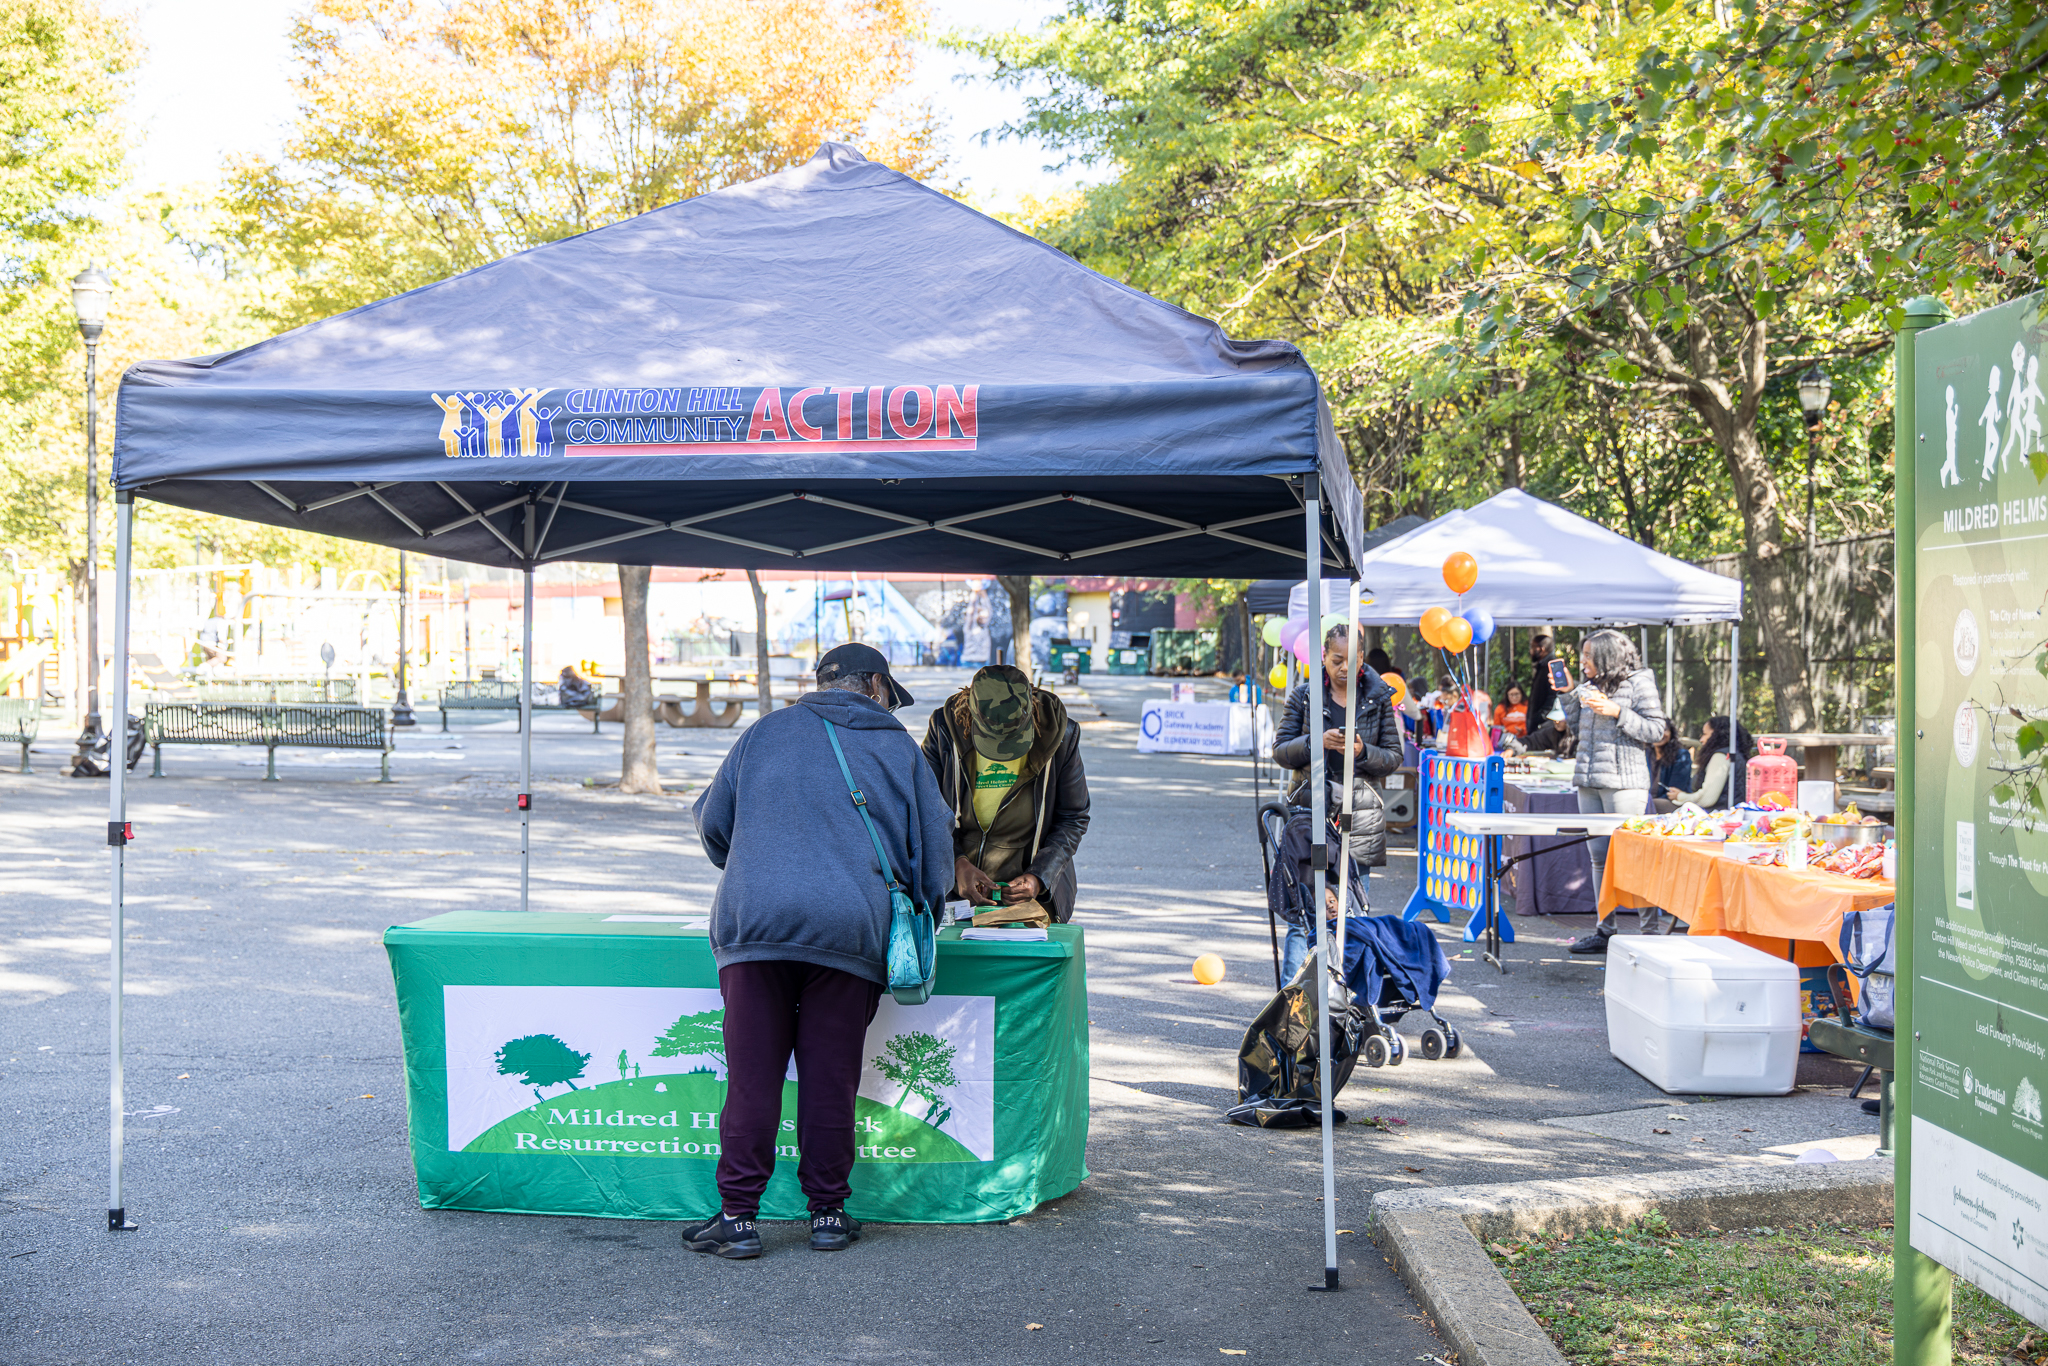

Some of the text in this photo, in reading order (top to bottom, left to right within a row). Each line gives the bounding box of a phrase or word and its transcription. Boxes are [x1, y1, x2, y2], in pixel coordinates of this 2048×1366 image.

[566, 387, 743, 413] CLINTON HILL
[566, 384, 981, 444] COMMUNITY ACTION
[1943, 496, 2047, 533] MILDRED HELMS
[1953, 568, 2029, 588] Restored in partnership with:
[1990, 609, 1999, 621] The
[2000, 609, 2011, 624] City
[2012, 608, 2018, 620] of
[1164, 710, 1185, 719] BRICK
[1164, 721, 1224, 731] Gateway Academy
[1164, 736, 1223, 747] ELEMENTARY SCHOOL
[1989, 852, 2007, 868] Through
[2008, 854, 2018, 868] The
[2019, 857, 2032, 871] Trust
[2033, 859, 2042, 873] for
[1935, 916, 1945, 928] With
[1946, 920, 1966, 934] additional
[1967, 926, 1984, 939] support
[2005, 935, 2010, 948] by
[2011, 936, 2032, 953] Episcopal
[1932, 931, 1946, 943] Clinton
[1955, 938, 1968, 950] Weed
[1968, 942, 1976, 953] and
[1977, 944, 1988, 955] Seed
[2016, 954, 2032, 969] PSE&G
[2033, 958, 2046, 973] South
[1946, 950, 1961, 963] Newark
[1963, 955, 1975, 968] Police
[2004, 969, 2012, 979] and
[2013, 970, 2029, 985] Clinton
[1976, 1020, 2045, 1060] Lead Funding Provided by:
[1975, 1078, 2005, 1105] Prudential
[1975, 1096, 1997, 1115] Foundation
[546, 1108, 680, 1127] Mildred
[854, 1116, 883, 1132] rk
[514, 1132, 721, 1156] Resurrection
[1977, 1169, 1997, 1188] Additional
[1998, 1179, 2014, 1199] funding
[2015, 1189, 2034, 1206] provided
[813, 1216, 842, 1228] USPA
